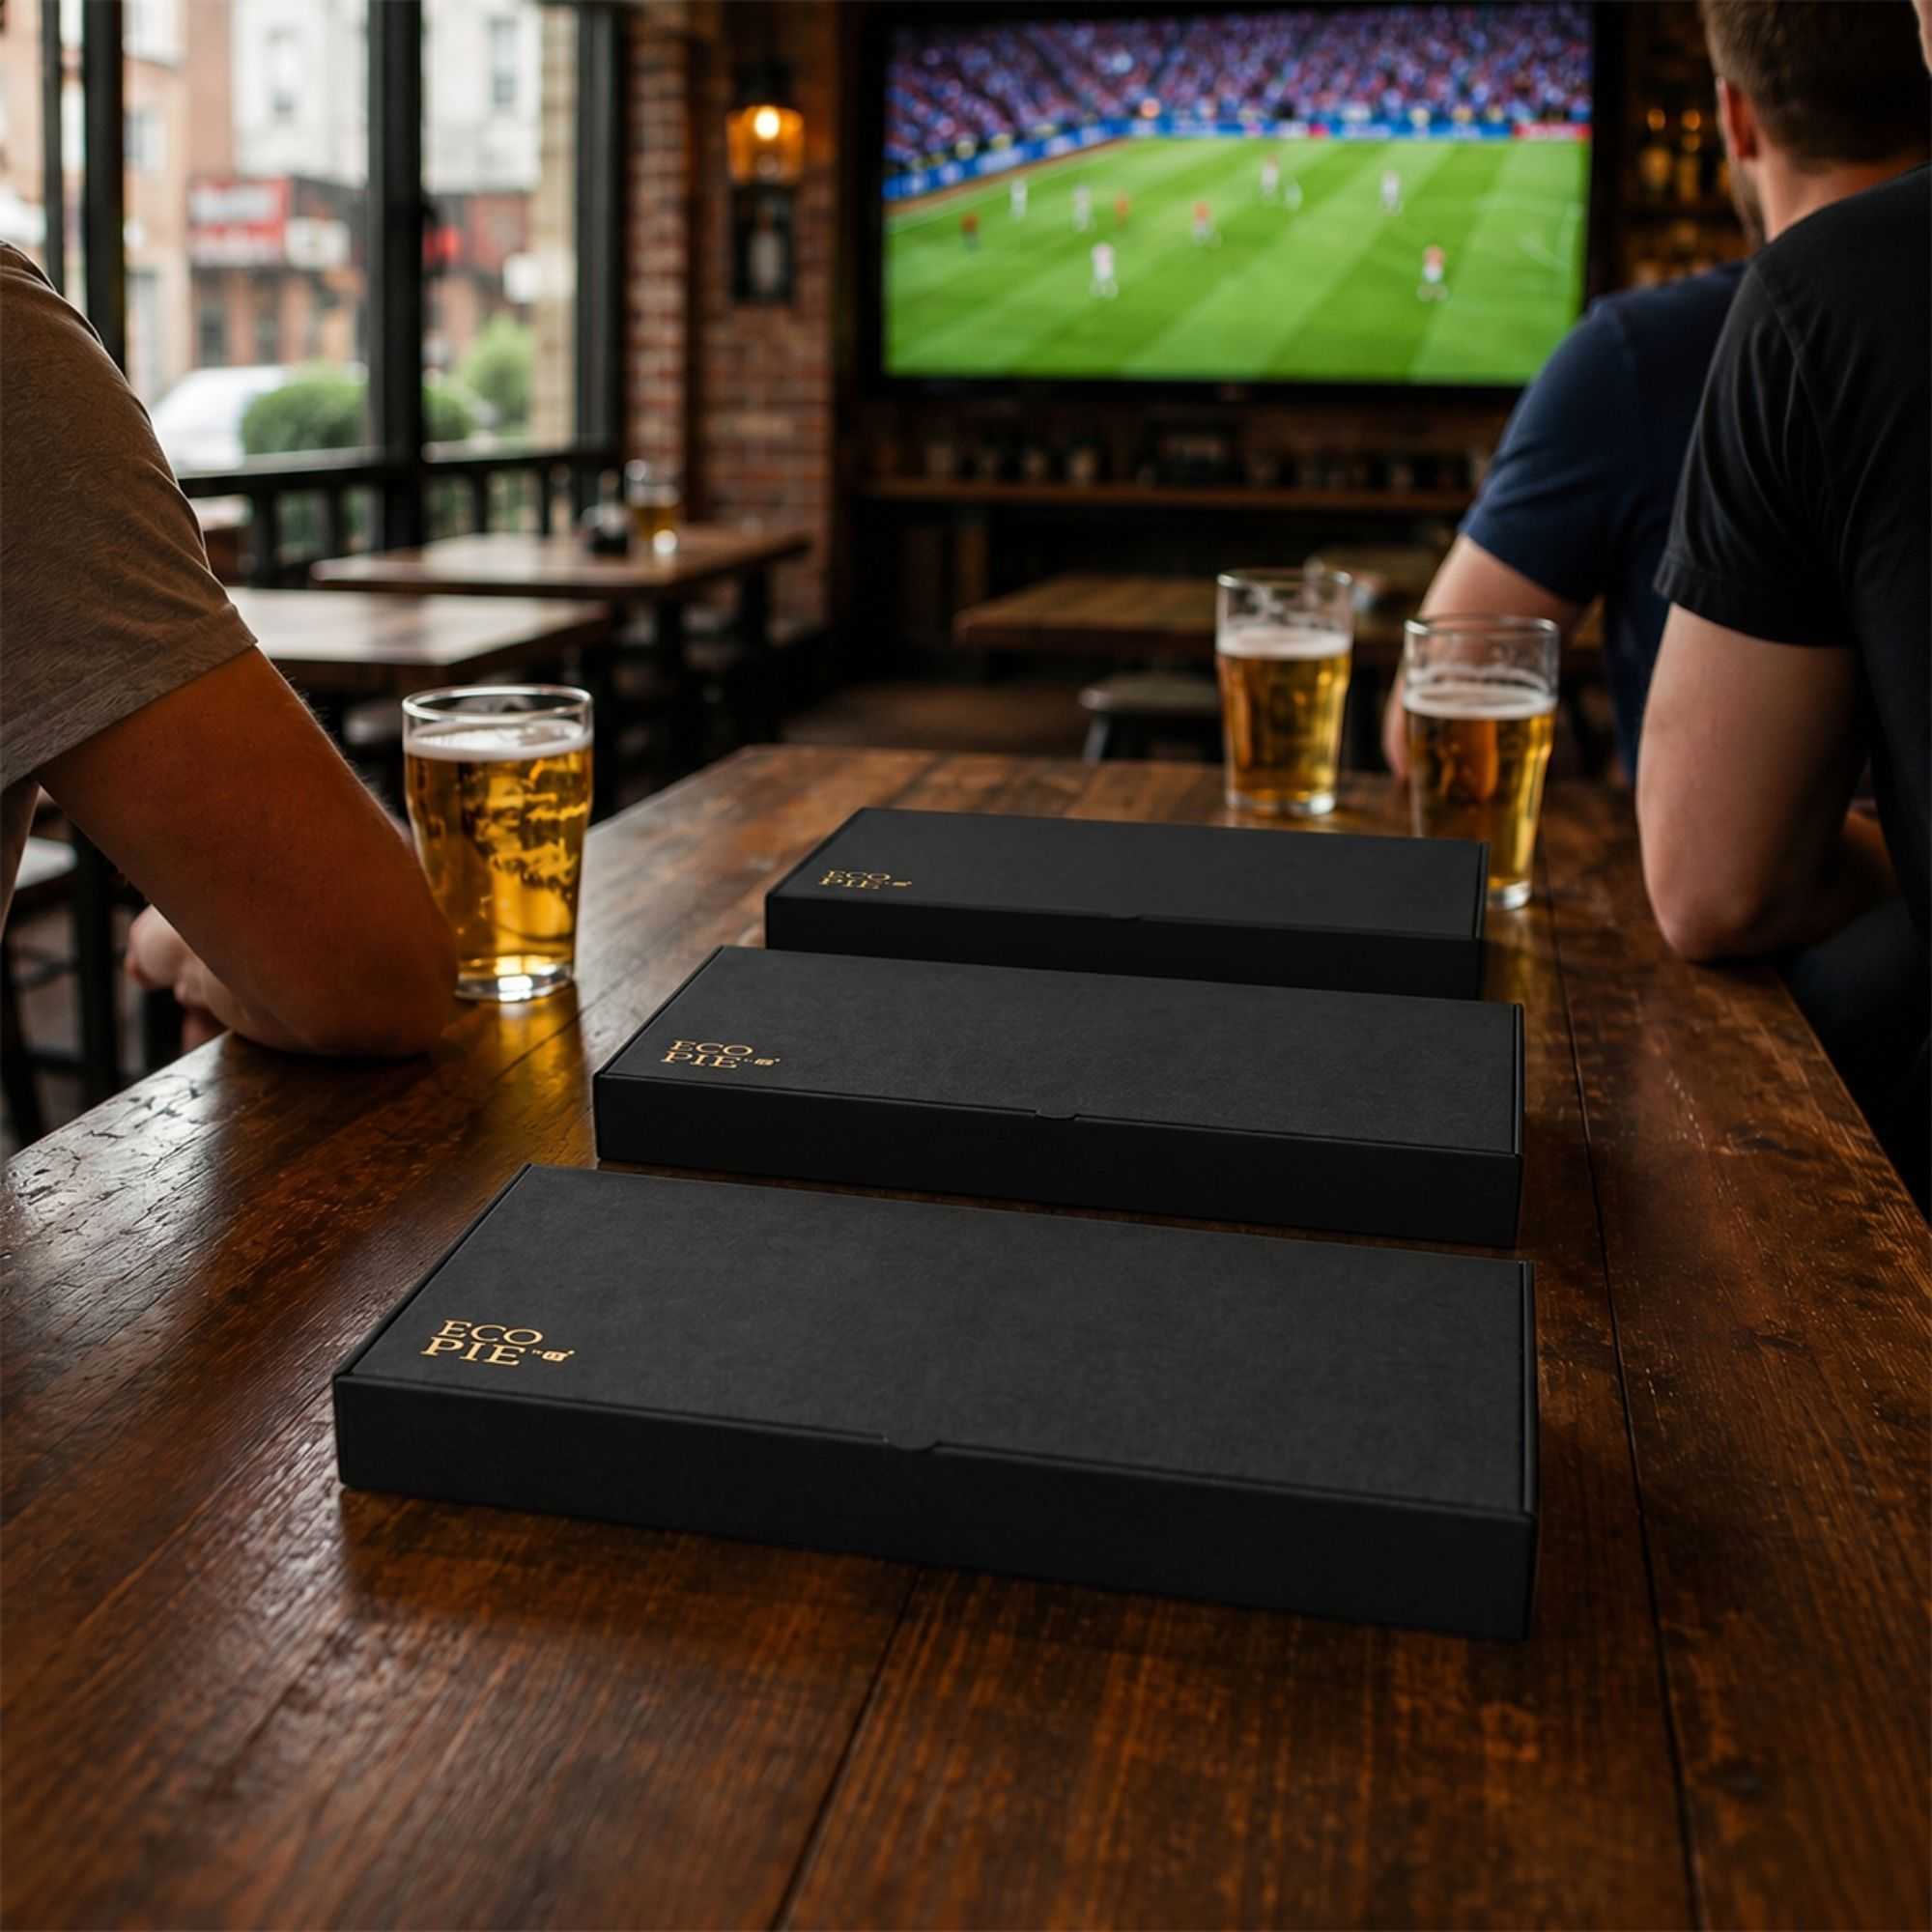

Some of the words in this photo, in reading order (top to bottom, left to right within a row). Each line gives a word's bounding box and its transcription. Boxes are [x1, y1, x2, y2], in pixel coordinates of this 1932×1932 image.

[670, 1039, 753, 1057] ECO
[660, 1051, 742, 1068] PIE
[438, 1320, 543, 1346] ECO
[421, 1336, 526, 1366] PIE
